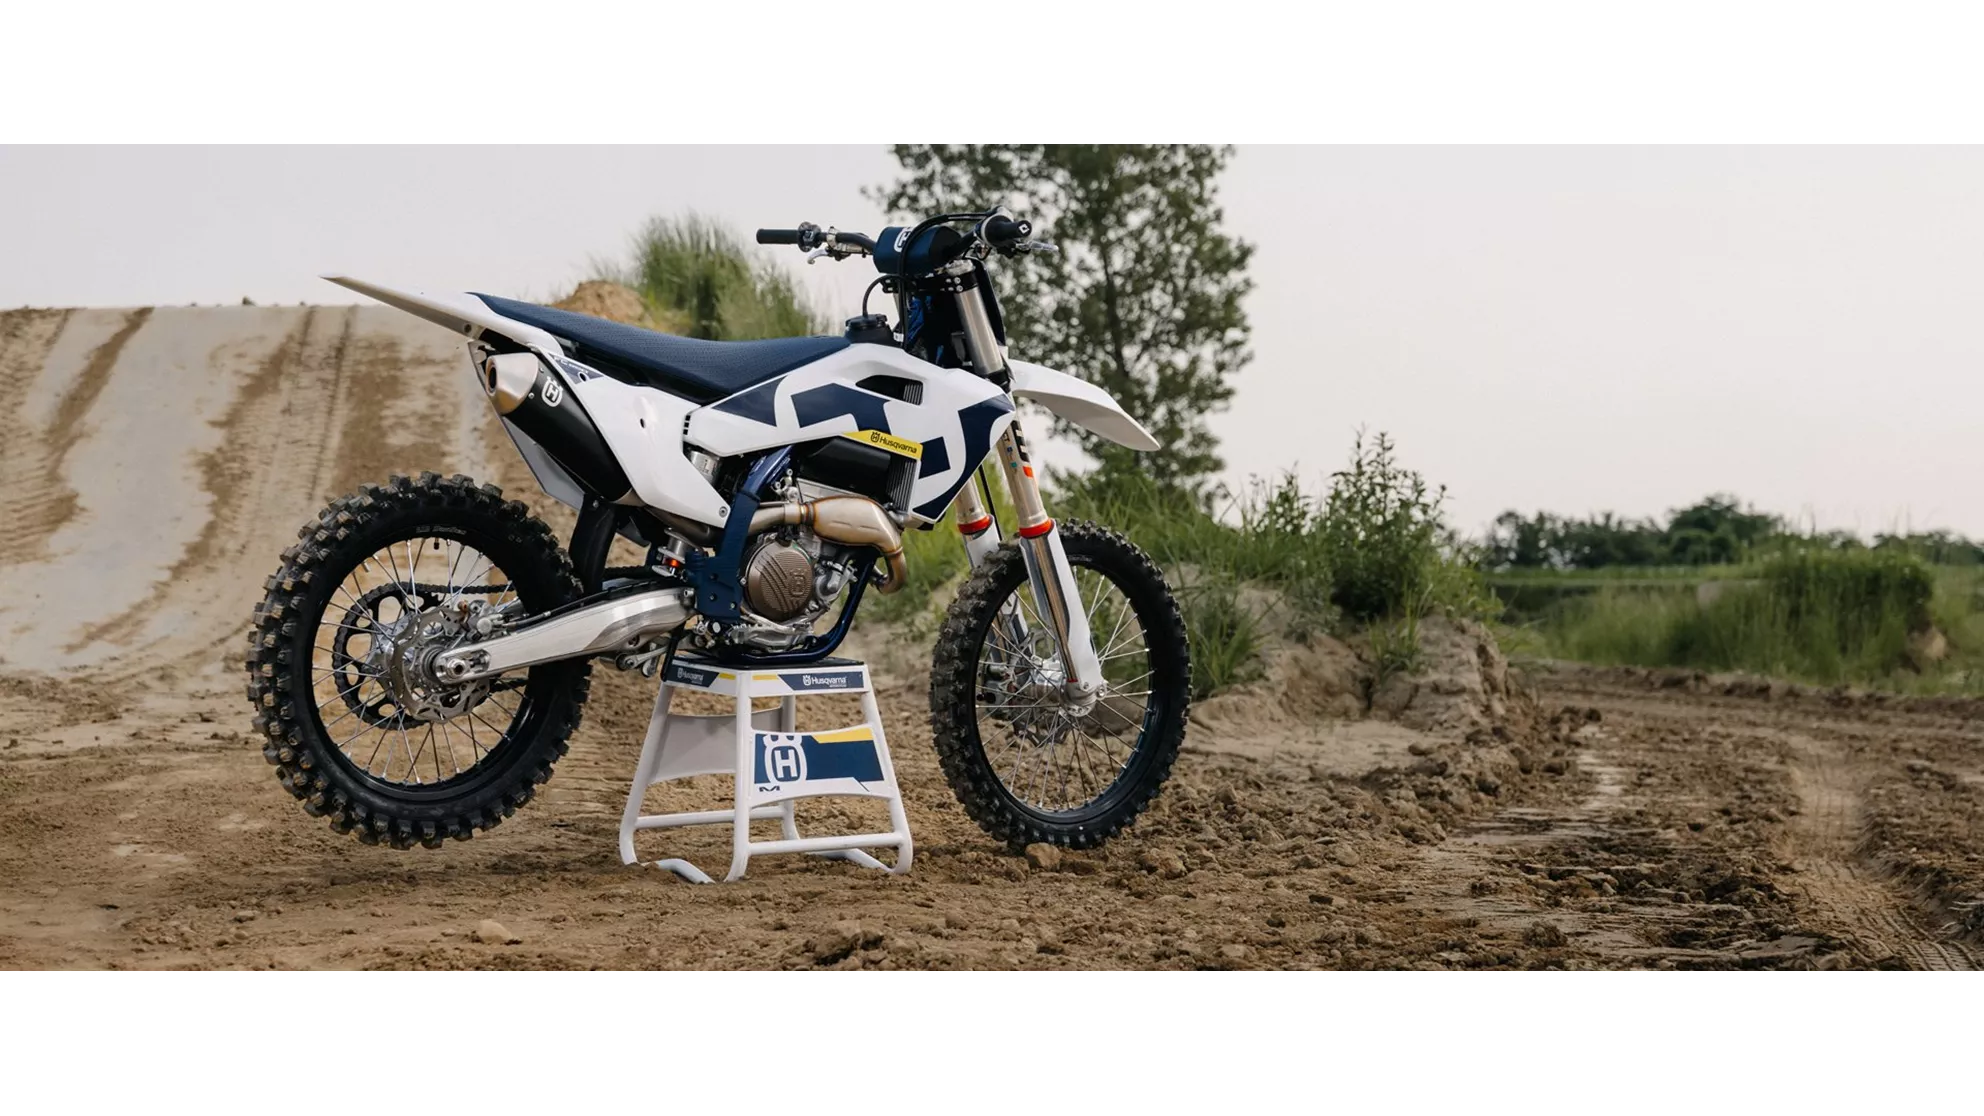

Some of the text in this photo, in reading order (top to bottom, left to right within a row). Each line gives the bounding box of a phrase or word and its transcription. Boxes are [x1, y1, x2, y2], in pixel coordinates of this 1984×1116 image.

[879, 436, 917, 454] Husqvarna
[812, 676, 846, 685] Husqvarna
[775, 748, 798, 778] H
